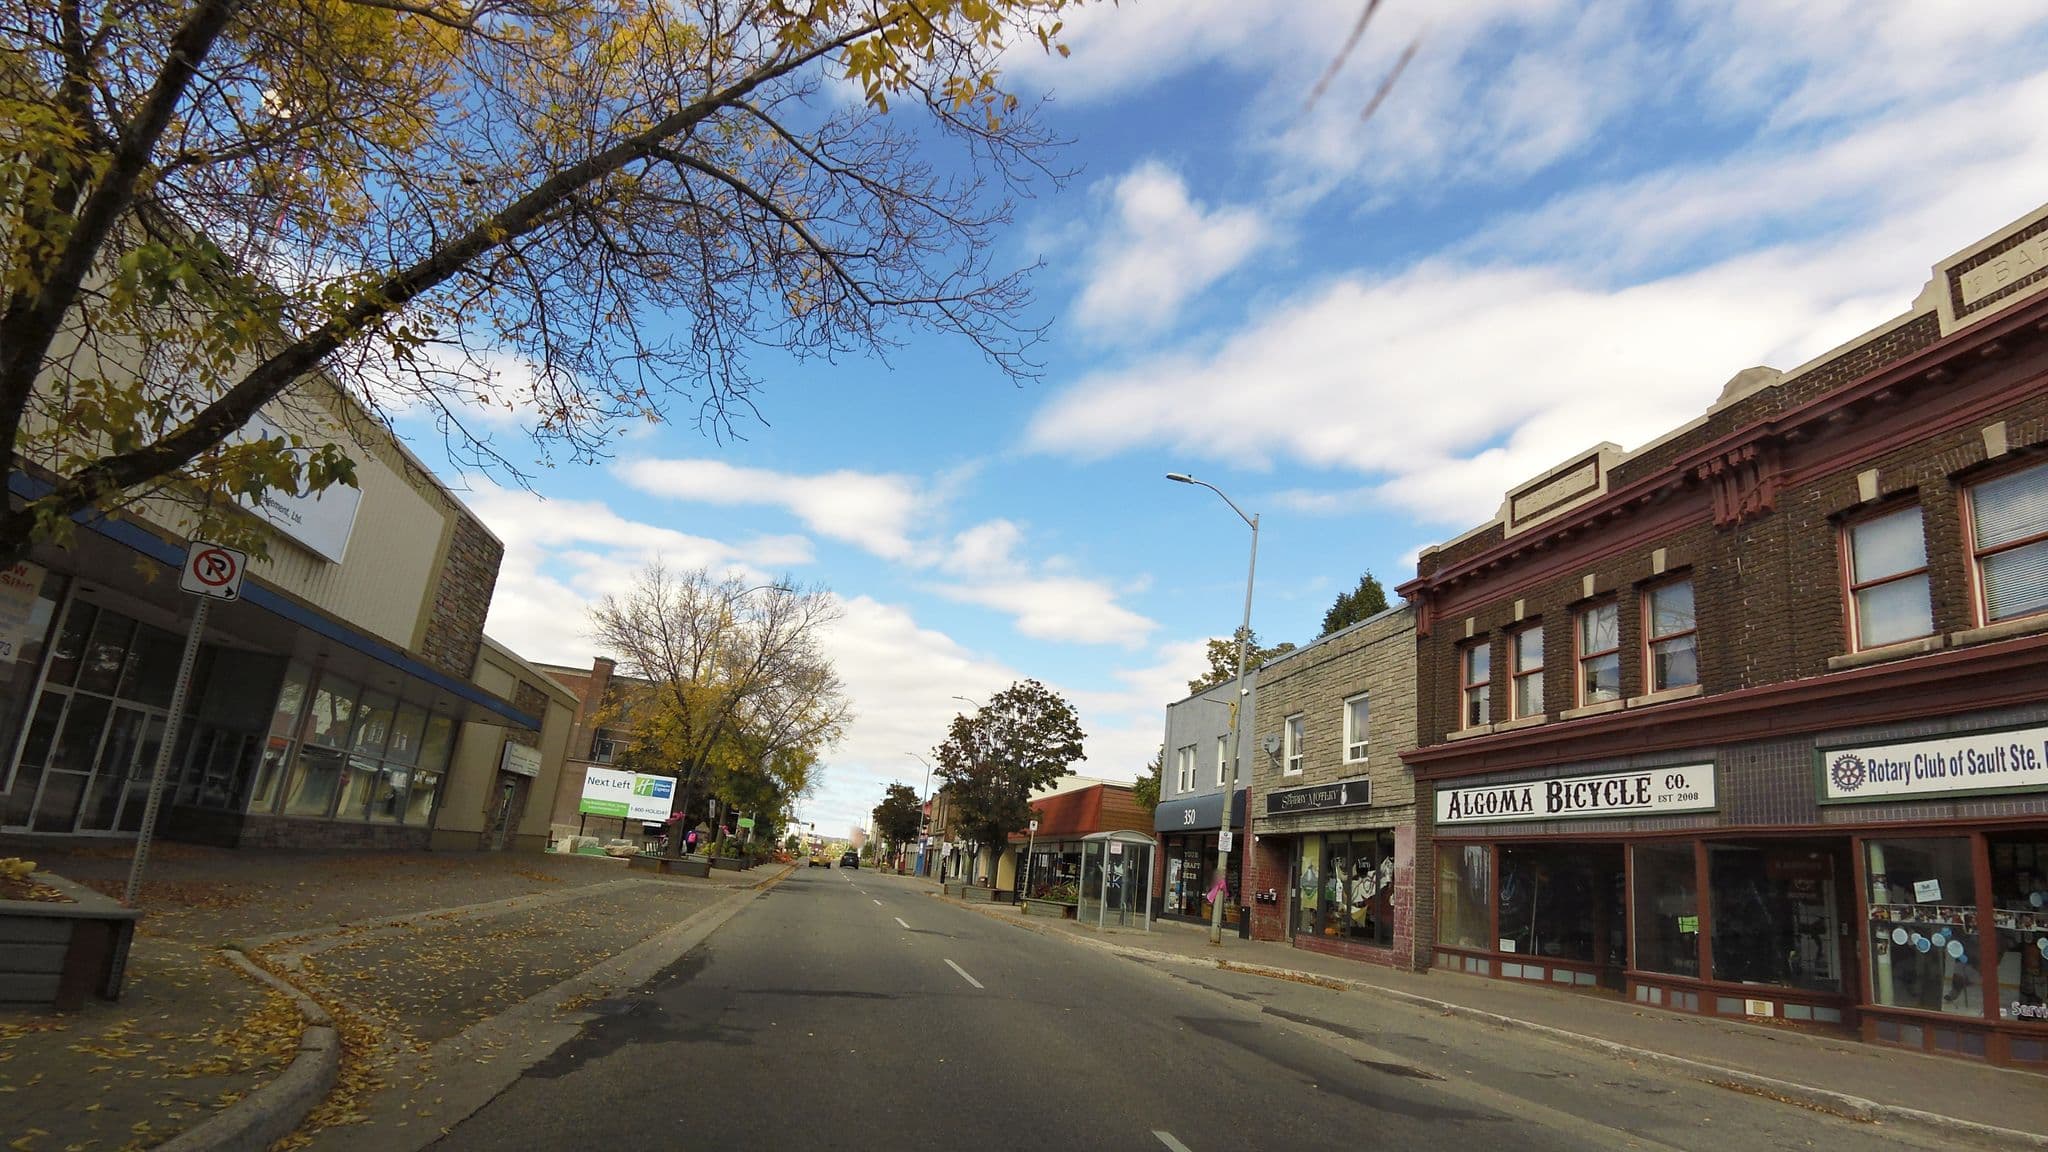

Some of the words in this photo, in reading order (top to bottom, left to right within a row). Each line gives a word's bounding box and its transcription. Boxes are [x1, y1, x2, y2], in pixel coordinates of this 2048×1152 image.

[1868, 758, 1911, 786] Rotary
[1914, 752, 1946, 779] Club
[1950, 750, 1964, 777] of
[1967, 746, 2007, 775] Sault
[2010, 743, 2041, 771] Ste.
[587, 776, 609, 787] Next
[612, 779, 631, 790] Left
[1447, 787, 1534, 820] ALGOMA
[1546, 777, 1652, 813] BICYCLE
[1665, 774, 1691, 790] CO.
[1658, 795, 1673, 803] EST
[1677, 792, 1699, 801] 2008
[1183, 808, 1196, 825] 350
